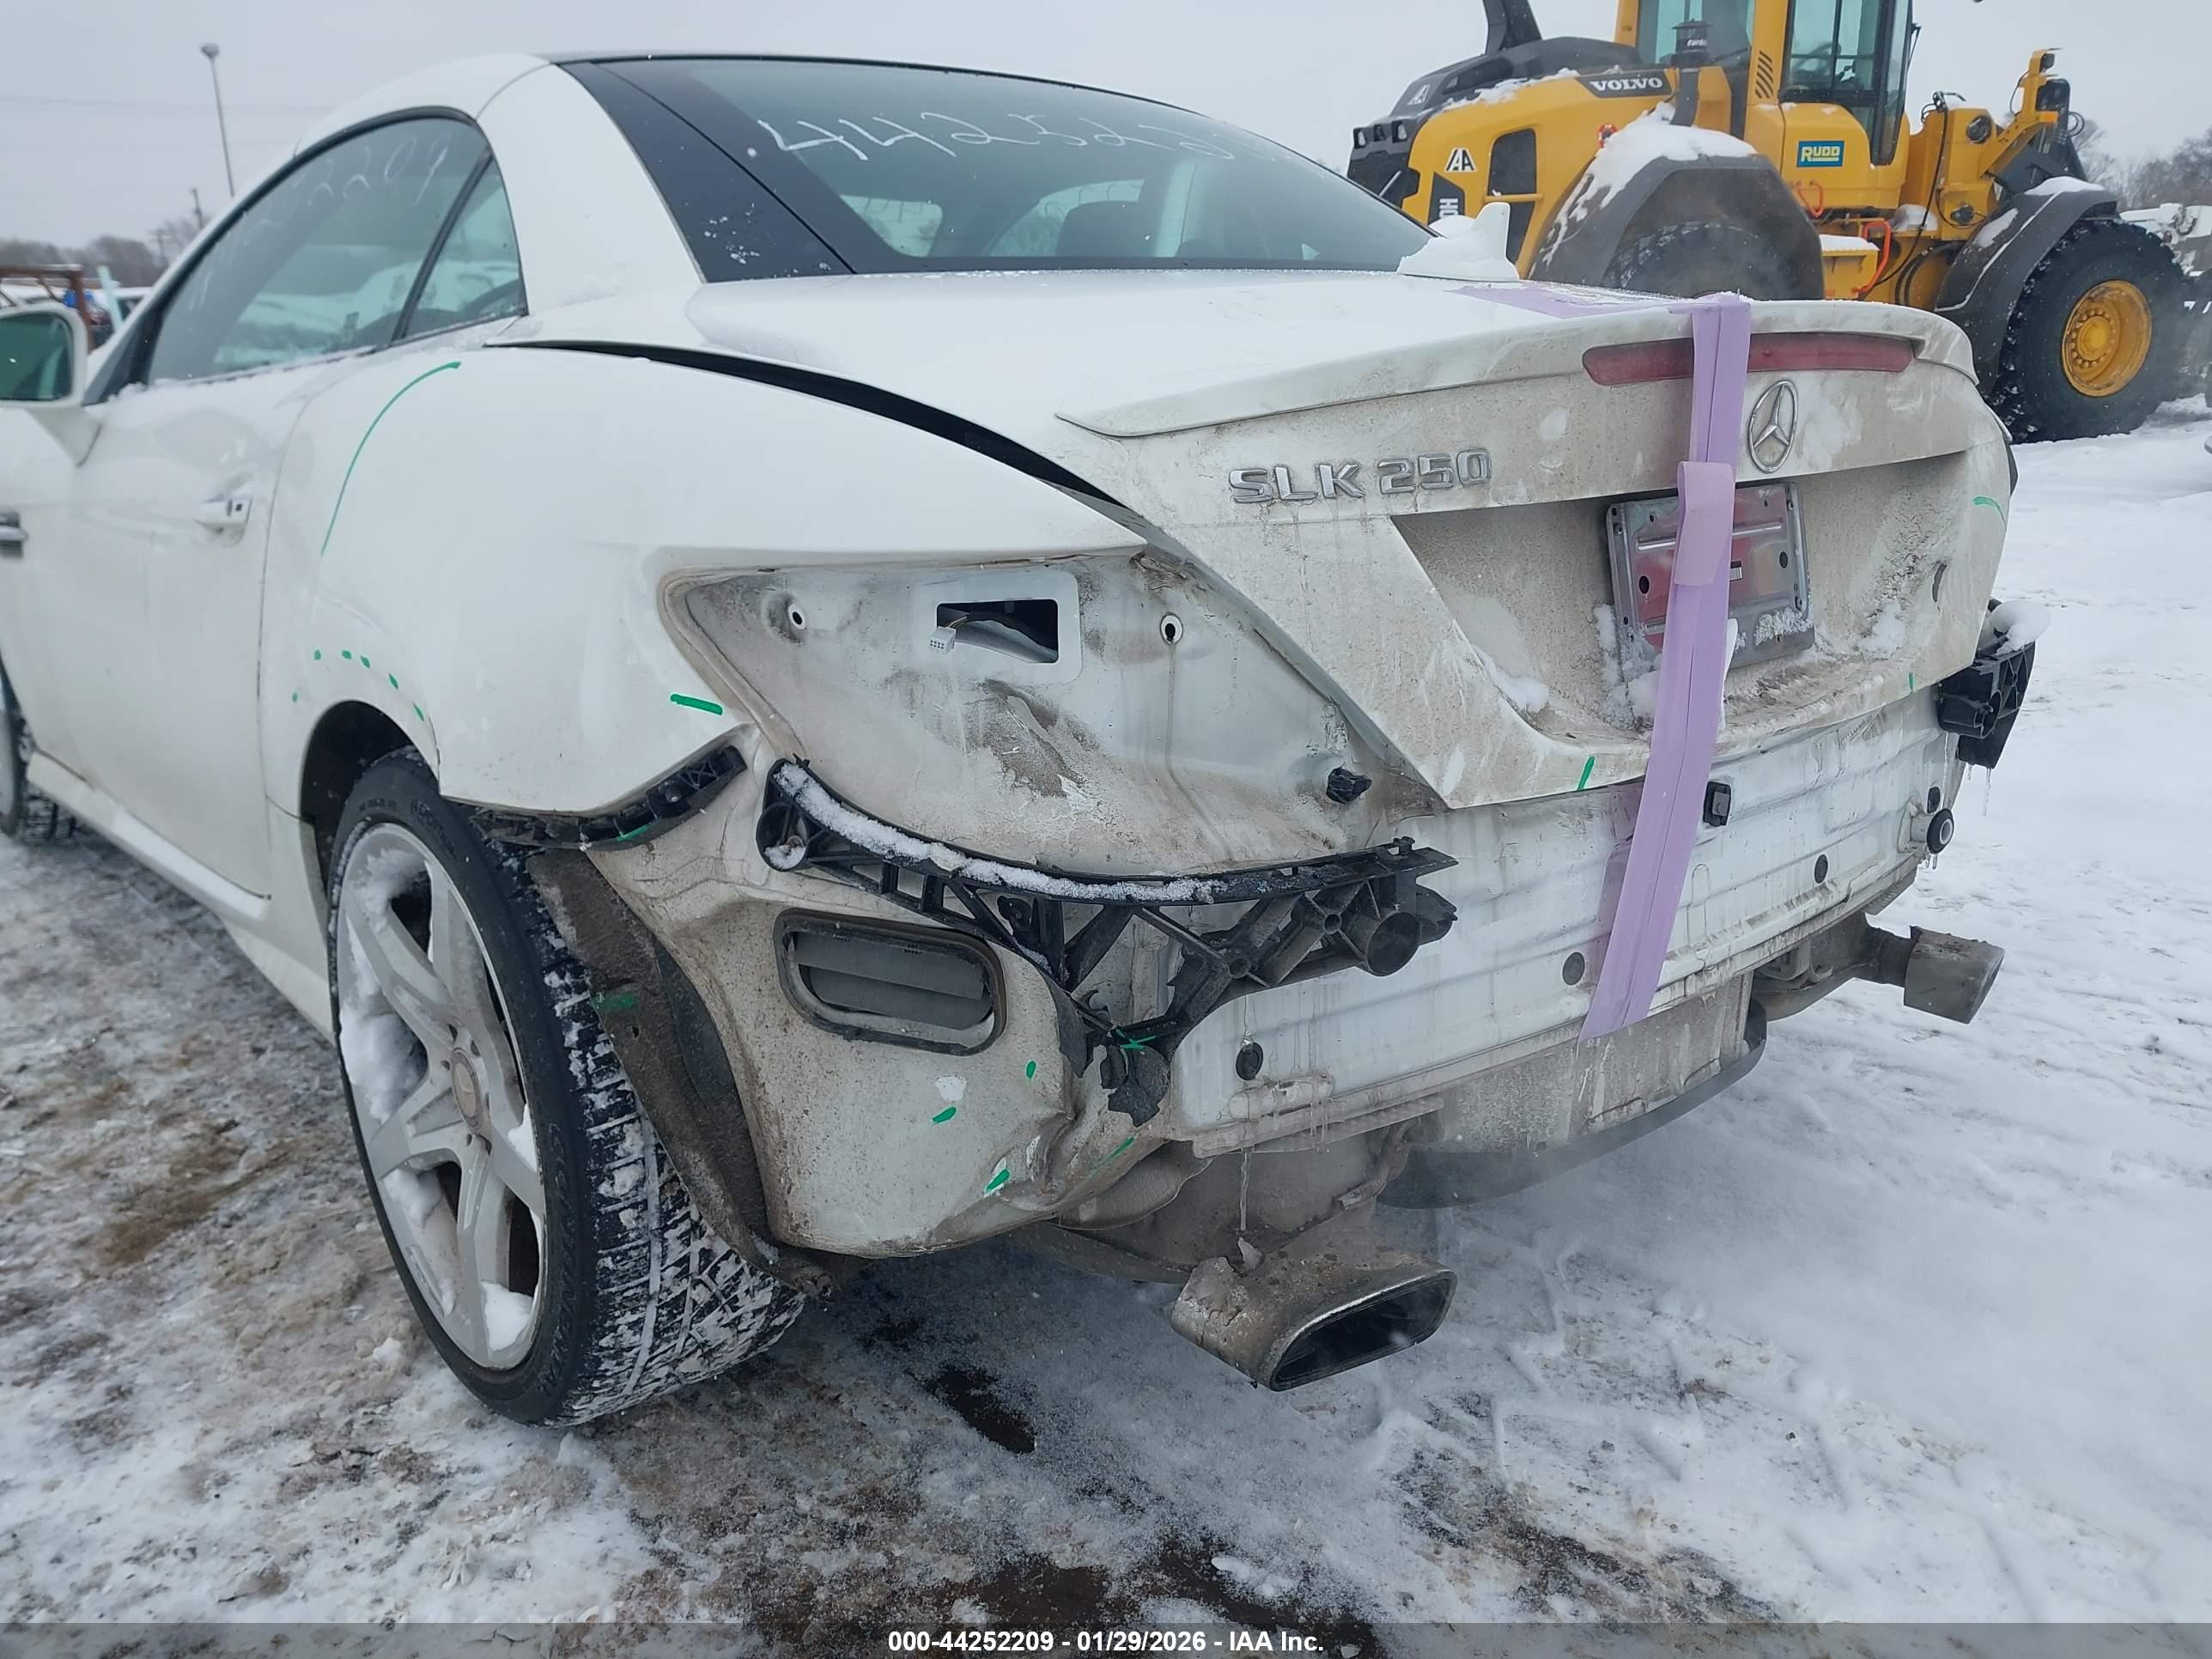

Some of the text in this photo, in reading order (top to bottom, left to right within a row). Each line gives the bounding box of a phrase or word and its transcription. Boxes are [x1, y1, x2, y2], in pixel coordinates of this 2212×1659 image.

[1589, 77, 1663, 92] VOLVO
[1801, 146, 1840, 161] RUDD
[1229, 447, 1492, 504] SLK 250
